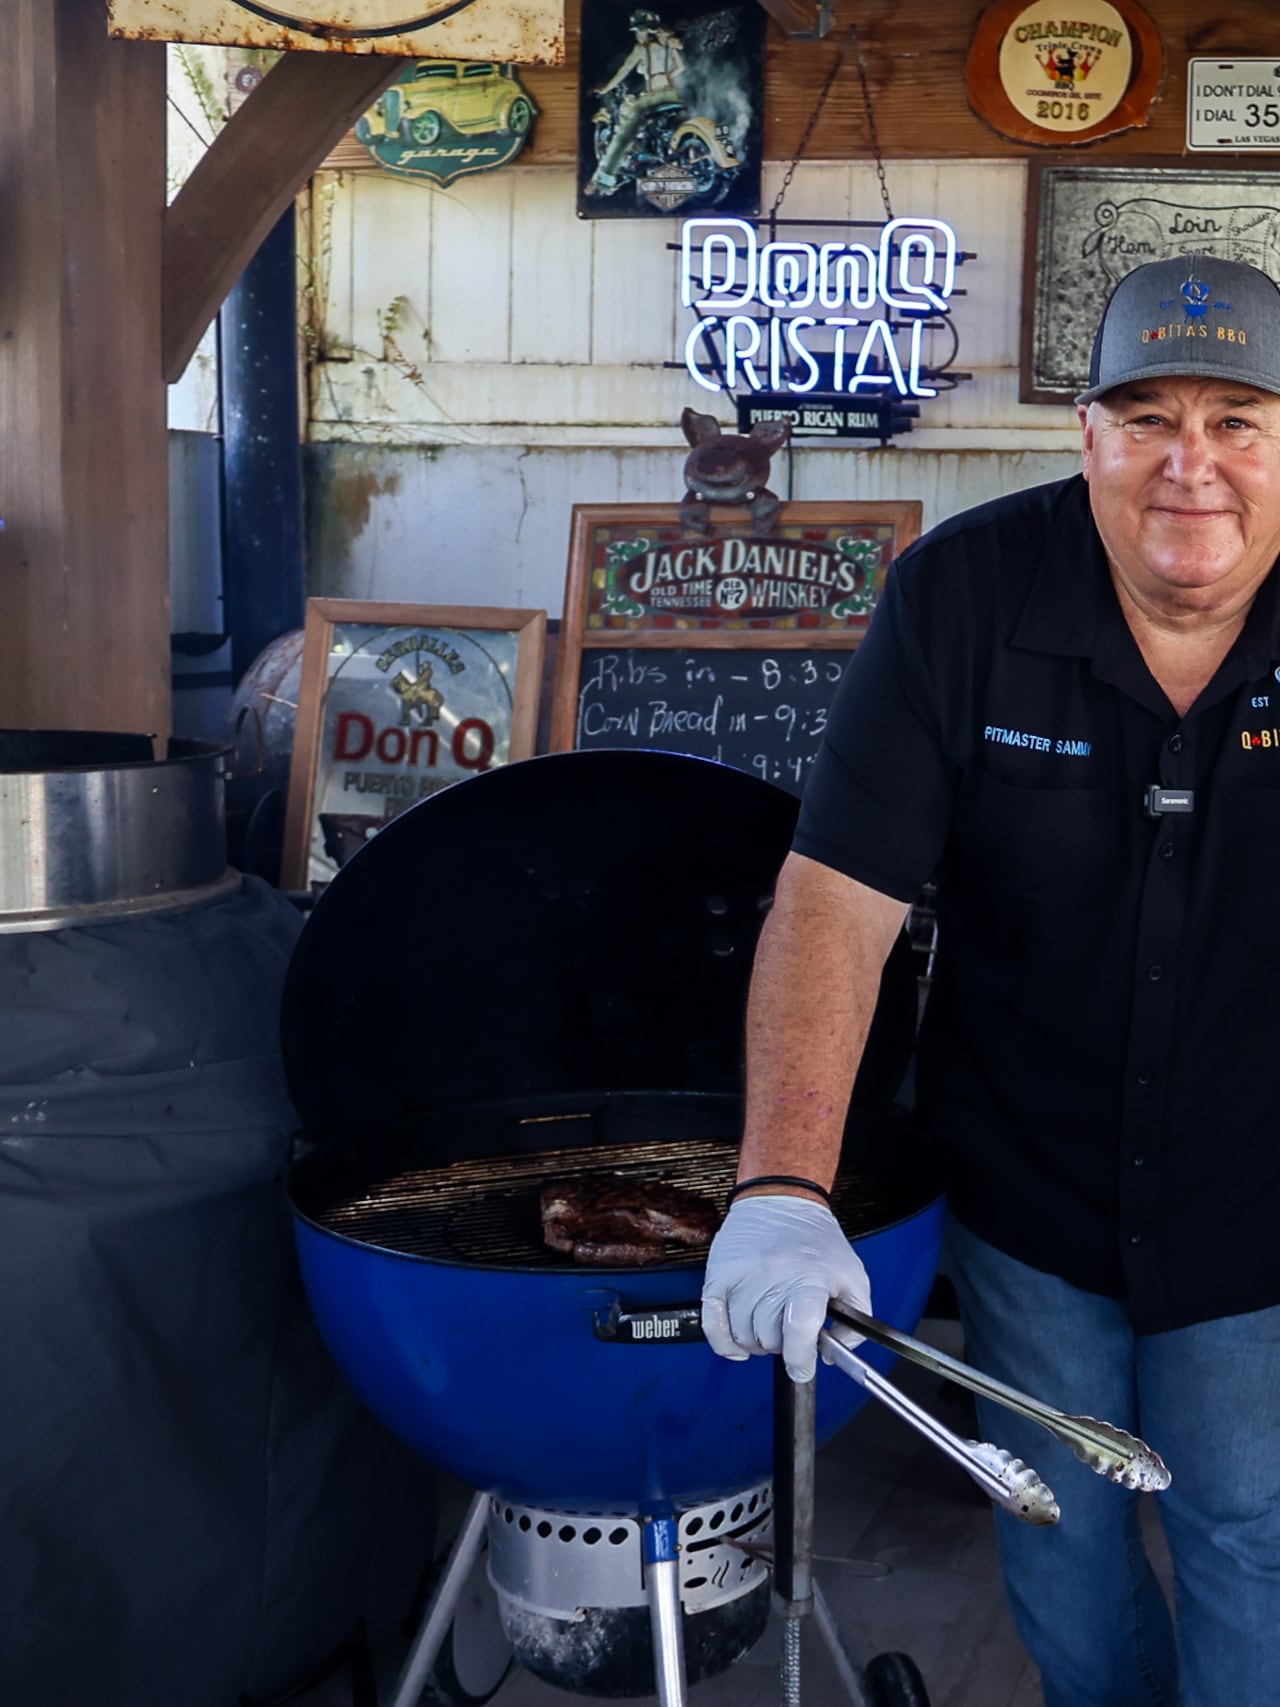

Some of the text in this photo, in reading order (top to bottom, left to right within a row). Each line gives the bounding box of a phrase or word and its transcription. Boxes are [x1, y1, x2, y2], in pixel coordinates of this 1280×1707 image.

[1014, 20, 1123, 48] CHAMPION
[1035, 42, 1067, 52] Triple
[1196, 85, 1200, 97] I
[1203, 85, 1245, 97] DON'T
[1246, 85, 1274, 97] DIAL
[1196, 110, 1200, 121] I
[1204, 110, 1236, 121] DIAL
[397, 148, 499, 165] garage
[1169, 212, 1222, 235] Loin
[1107, 234, 1155, 254] Ham
[1217, 325, 1247, 345] BBQ
[684, 315, 938, 398] CRISTAL
[803, 411, 844, 427] RICAN
[847, 412, 879, 428] RUM
[630, 539, 857, 593] JACK DANIEL'S
[651, 579, 713, 596] OLD TIME
[723, 580, 742, 589] OLD
[750, 577, 832, 608] WHISKEY
[650, 596, 712, 608] TENNESSEE
[1251, 696, 1270, 708] EST
[775, 704, 828, 741] 9:3
[333, 711, 495, 772] Don Q
[984, 725, 1051, 752] PITMASTER
[343, 771, 416, 797] PUERTO
[631, 1314, 680, 1339] weber
